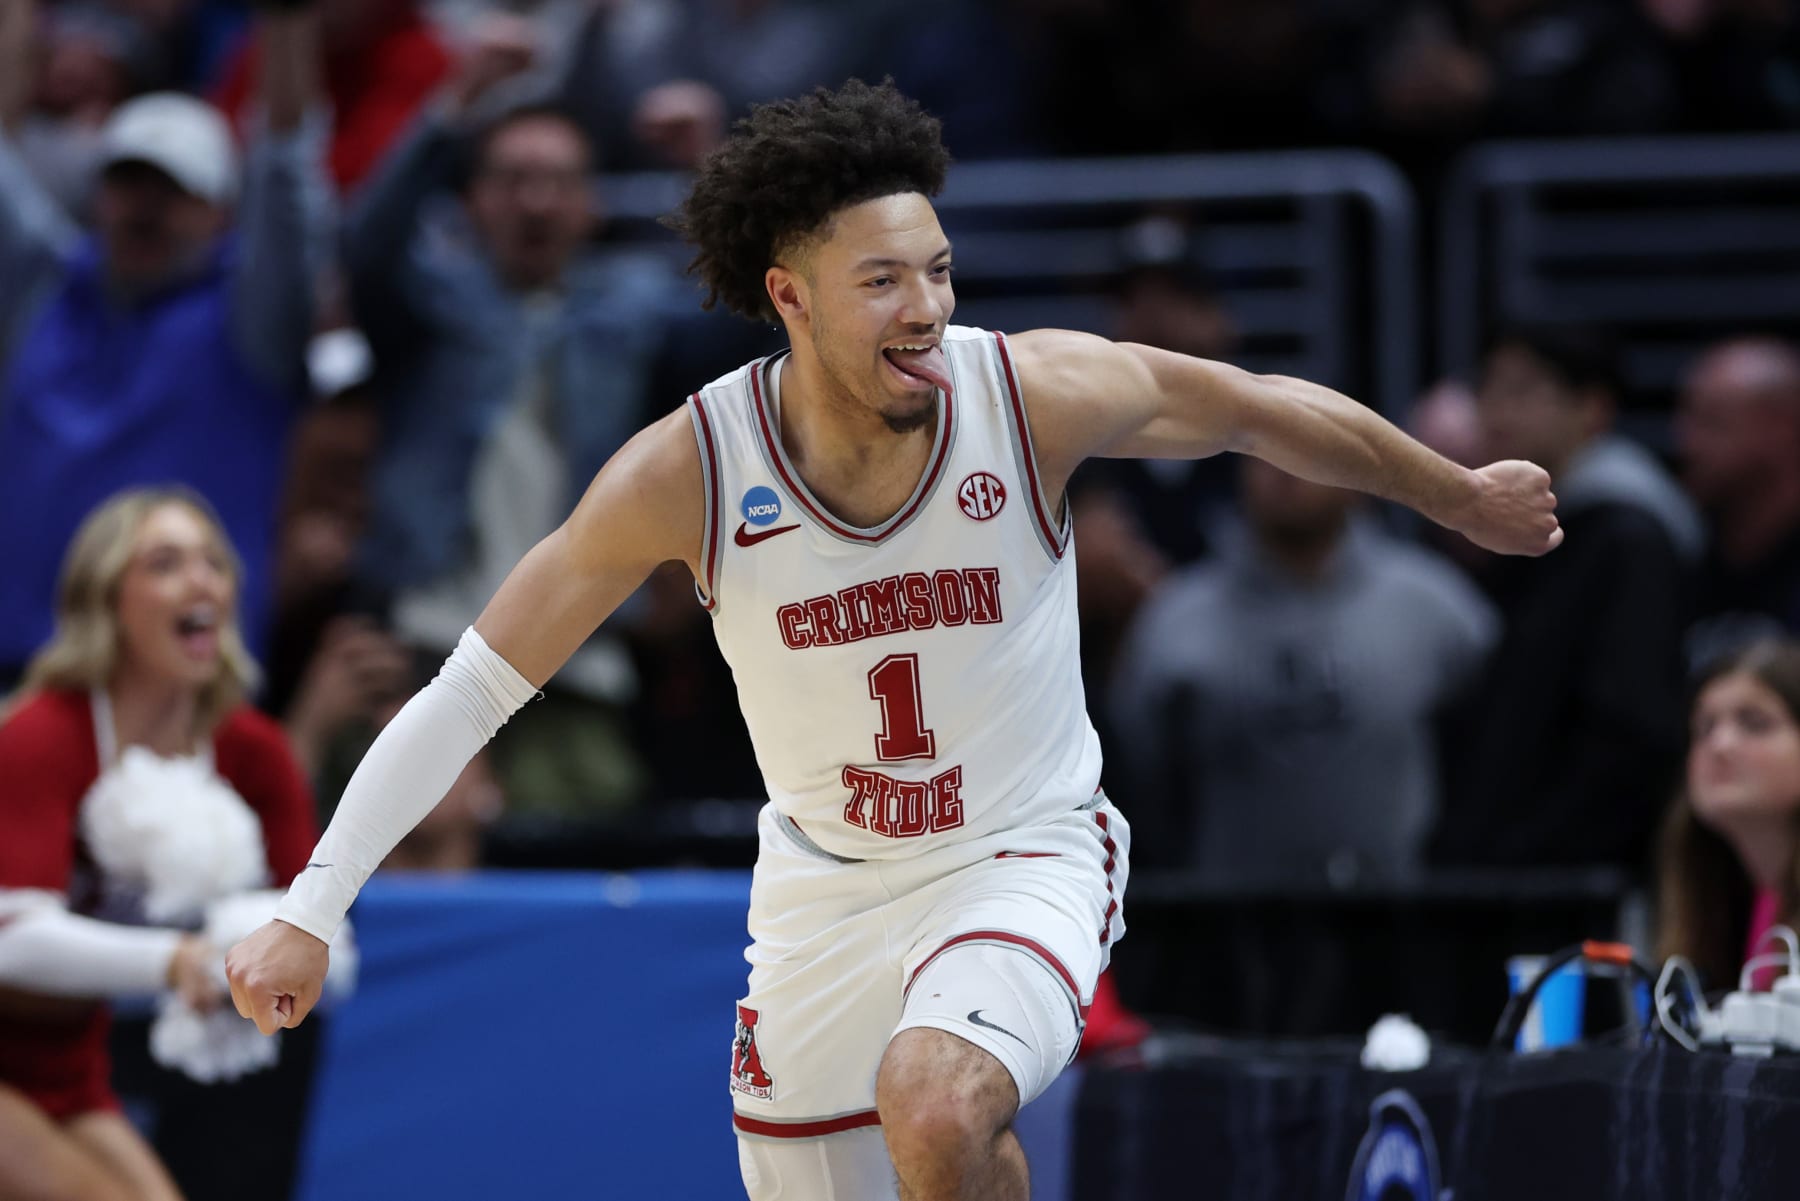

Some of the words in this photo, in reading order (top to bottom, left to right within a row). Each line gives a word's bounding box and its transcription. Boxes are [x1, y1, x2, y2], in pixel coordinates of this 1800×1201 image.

[748, 503, 779, 518] NCAA
[959, 474, 1005, 518] SEC
[776, 567, 1003, 650] CRIMSON
[867, 652, 936, 762] 1
[841, 764, 964, 838] TIDE
[753, 1086, 769, 1097] TIDE
